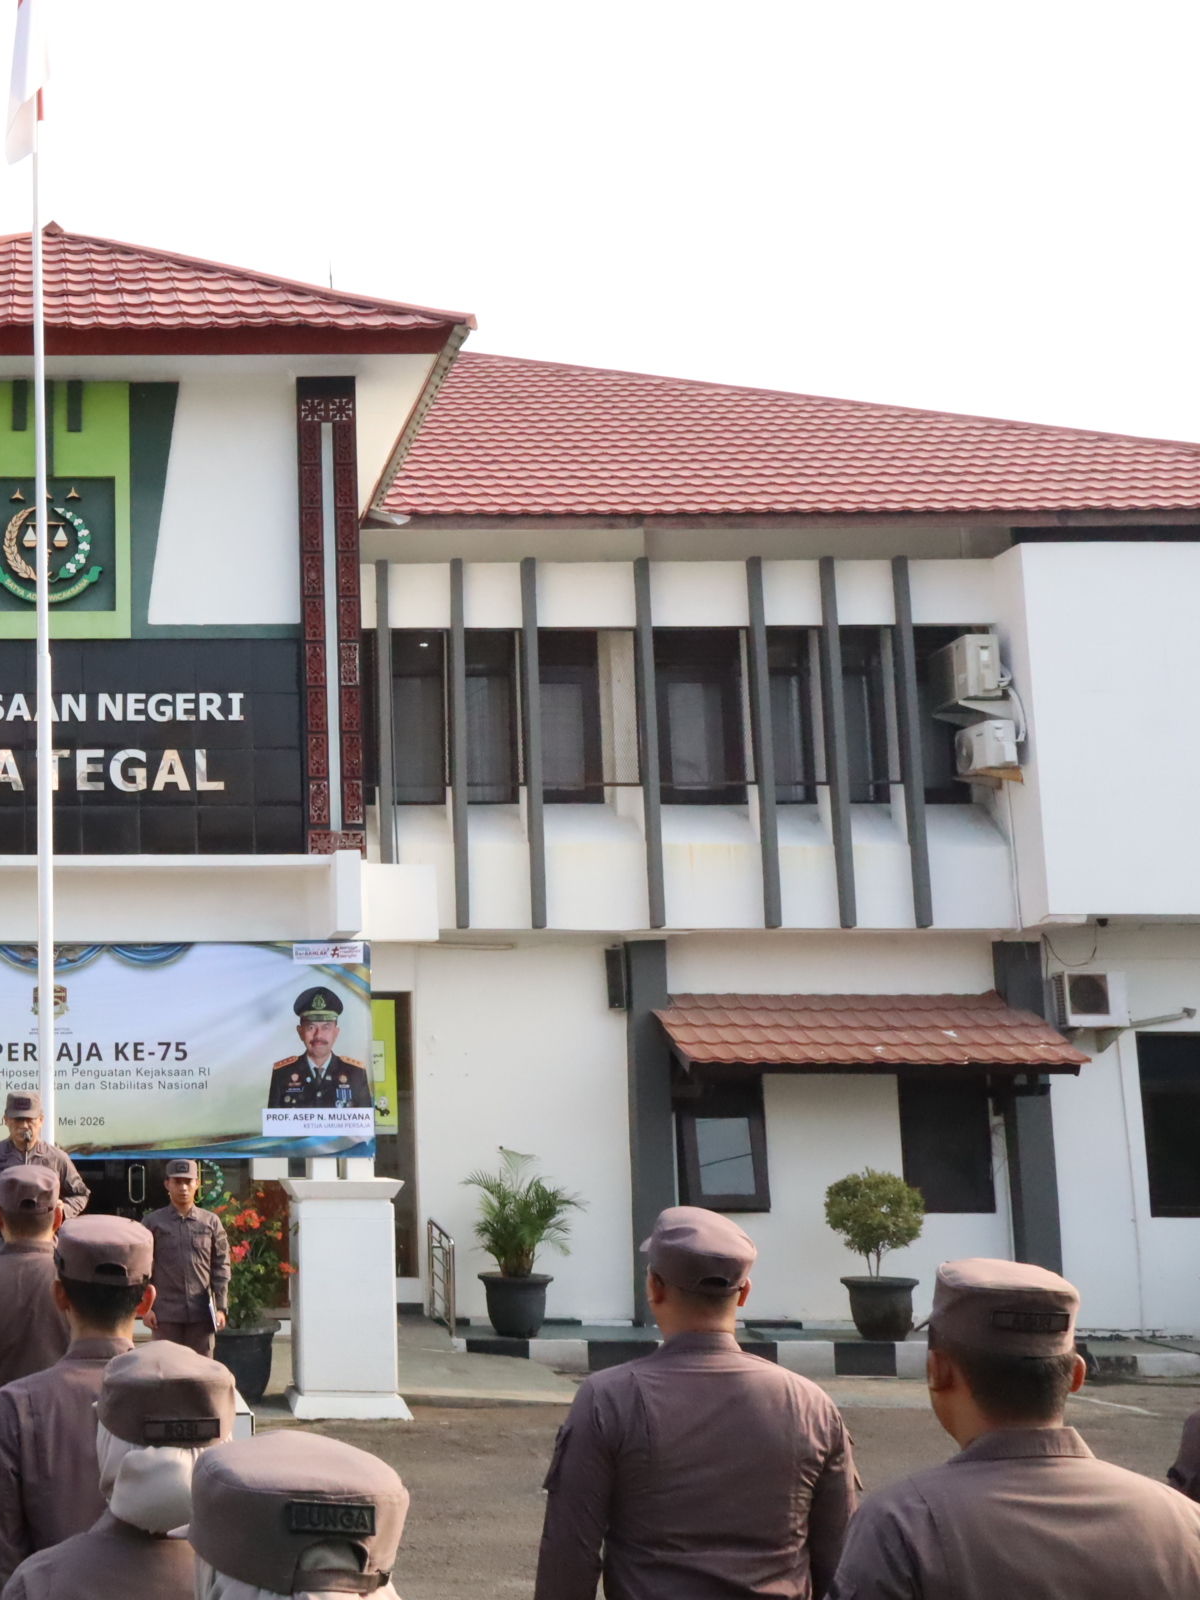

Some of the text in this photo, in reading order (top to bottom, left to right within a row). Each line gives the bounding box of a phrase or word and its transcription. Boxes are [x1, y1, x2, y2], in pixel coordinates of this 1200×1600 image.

[4, 578, 25, 597] SATYA
[98, 692, 244, 722] NEGERI
[114, 1041, 188, 1062] KE-75
[71, 1068, 131, 1080] Penguatan
[136, 1067, 194, 1079] Kejaksaan
[198, 1067, 210, 1076] RI
[74, 1080, 95, 1090] dan
[100, 1080, 154, 1090] Stabilitas
[158, 1080, 208, 1090] Nasional
[58, 1117, 105, 1126] Mei 2026
[266, 1113, 371, 1121] PROF. ASEP N. MULYANA
